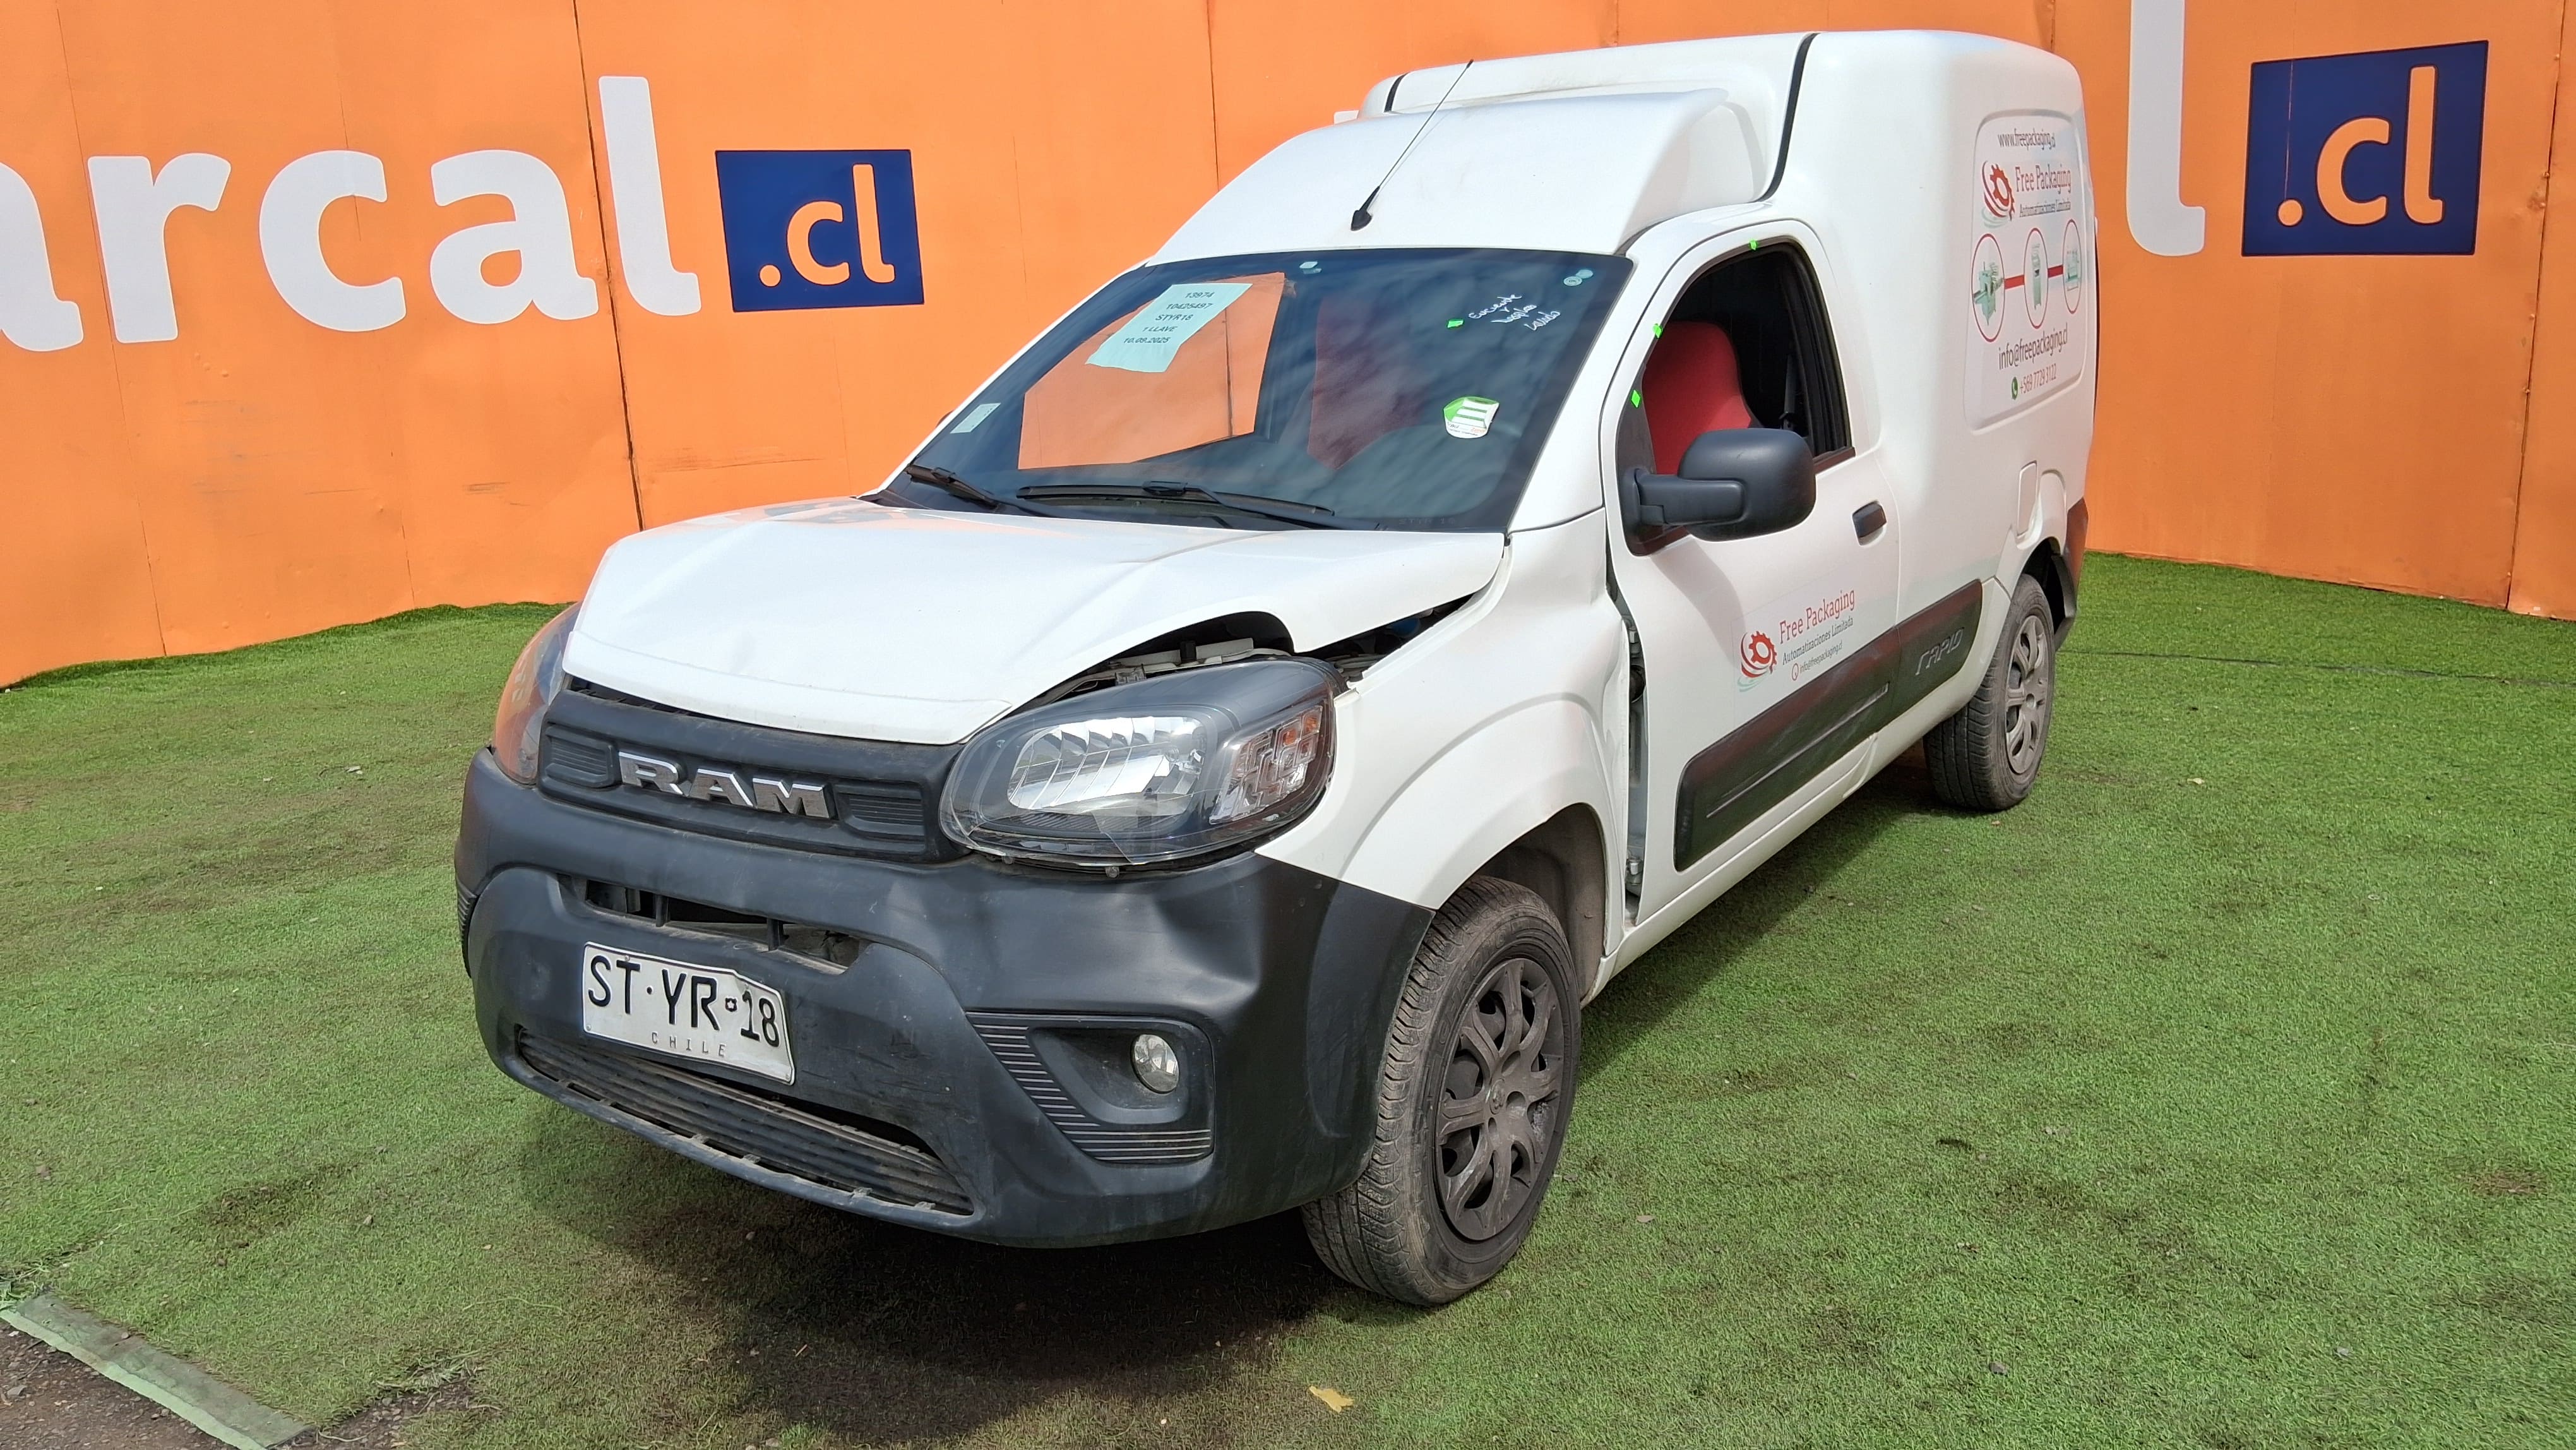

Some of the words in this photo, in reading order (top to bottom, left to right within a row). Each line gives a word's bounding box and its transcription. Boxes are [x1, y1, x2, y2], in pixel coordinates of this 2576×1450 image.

[2277, 65, 2444, 225] .cl
[2015, 166, 2034, 193] Free
[2035, 163, 2072, 195] Packaging
[760, 164, 896, 287] .cl
[1999, 321, 2068, 370] info@freepackaging.cl
[1780, 618, 1803, 644] Free
[1806, 590, 1855, 630] Packaging
[1782, 630, 1830, 666] Automatizaciones
[1832, 615, 1854, 637] Limitada
[618, 751, 835, 820] RAM
[651, 1031, 727, 1057] CHILE
